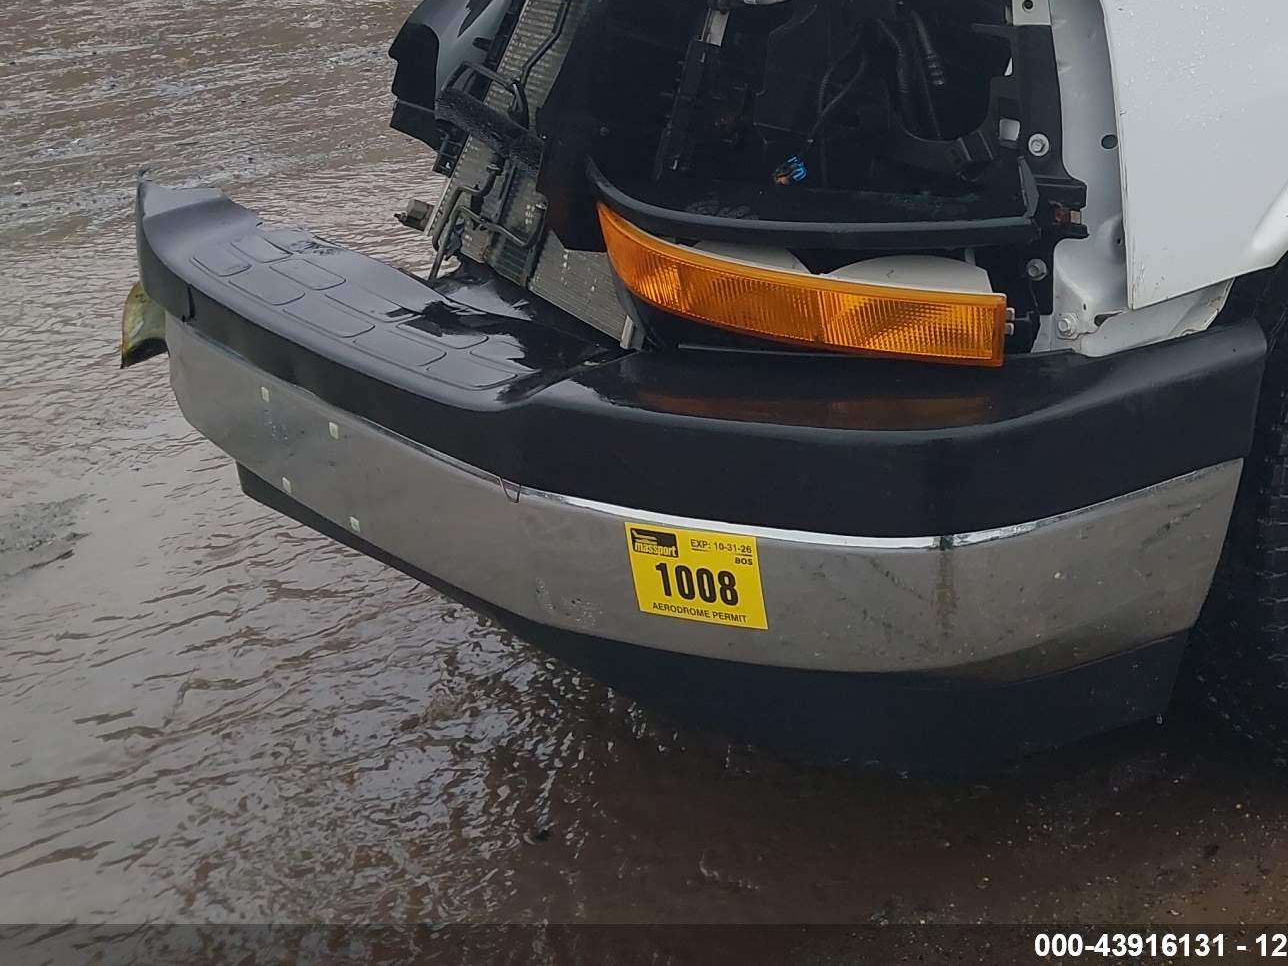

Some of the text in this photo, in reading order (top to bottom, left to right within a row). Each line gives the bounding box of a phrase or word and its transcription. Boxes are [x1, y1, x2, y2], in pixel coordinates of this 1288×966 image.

[634, 541, 677, 556] massport
[690, 539, 753, 553] EXP: 10-31-26
[734, 556, 753, 566] BOS
[655, 562, 739, 606] 1008
[652, 601, 748, 623] AERODROME PERMIT
